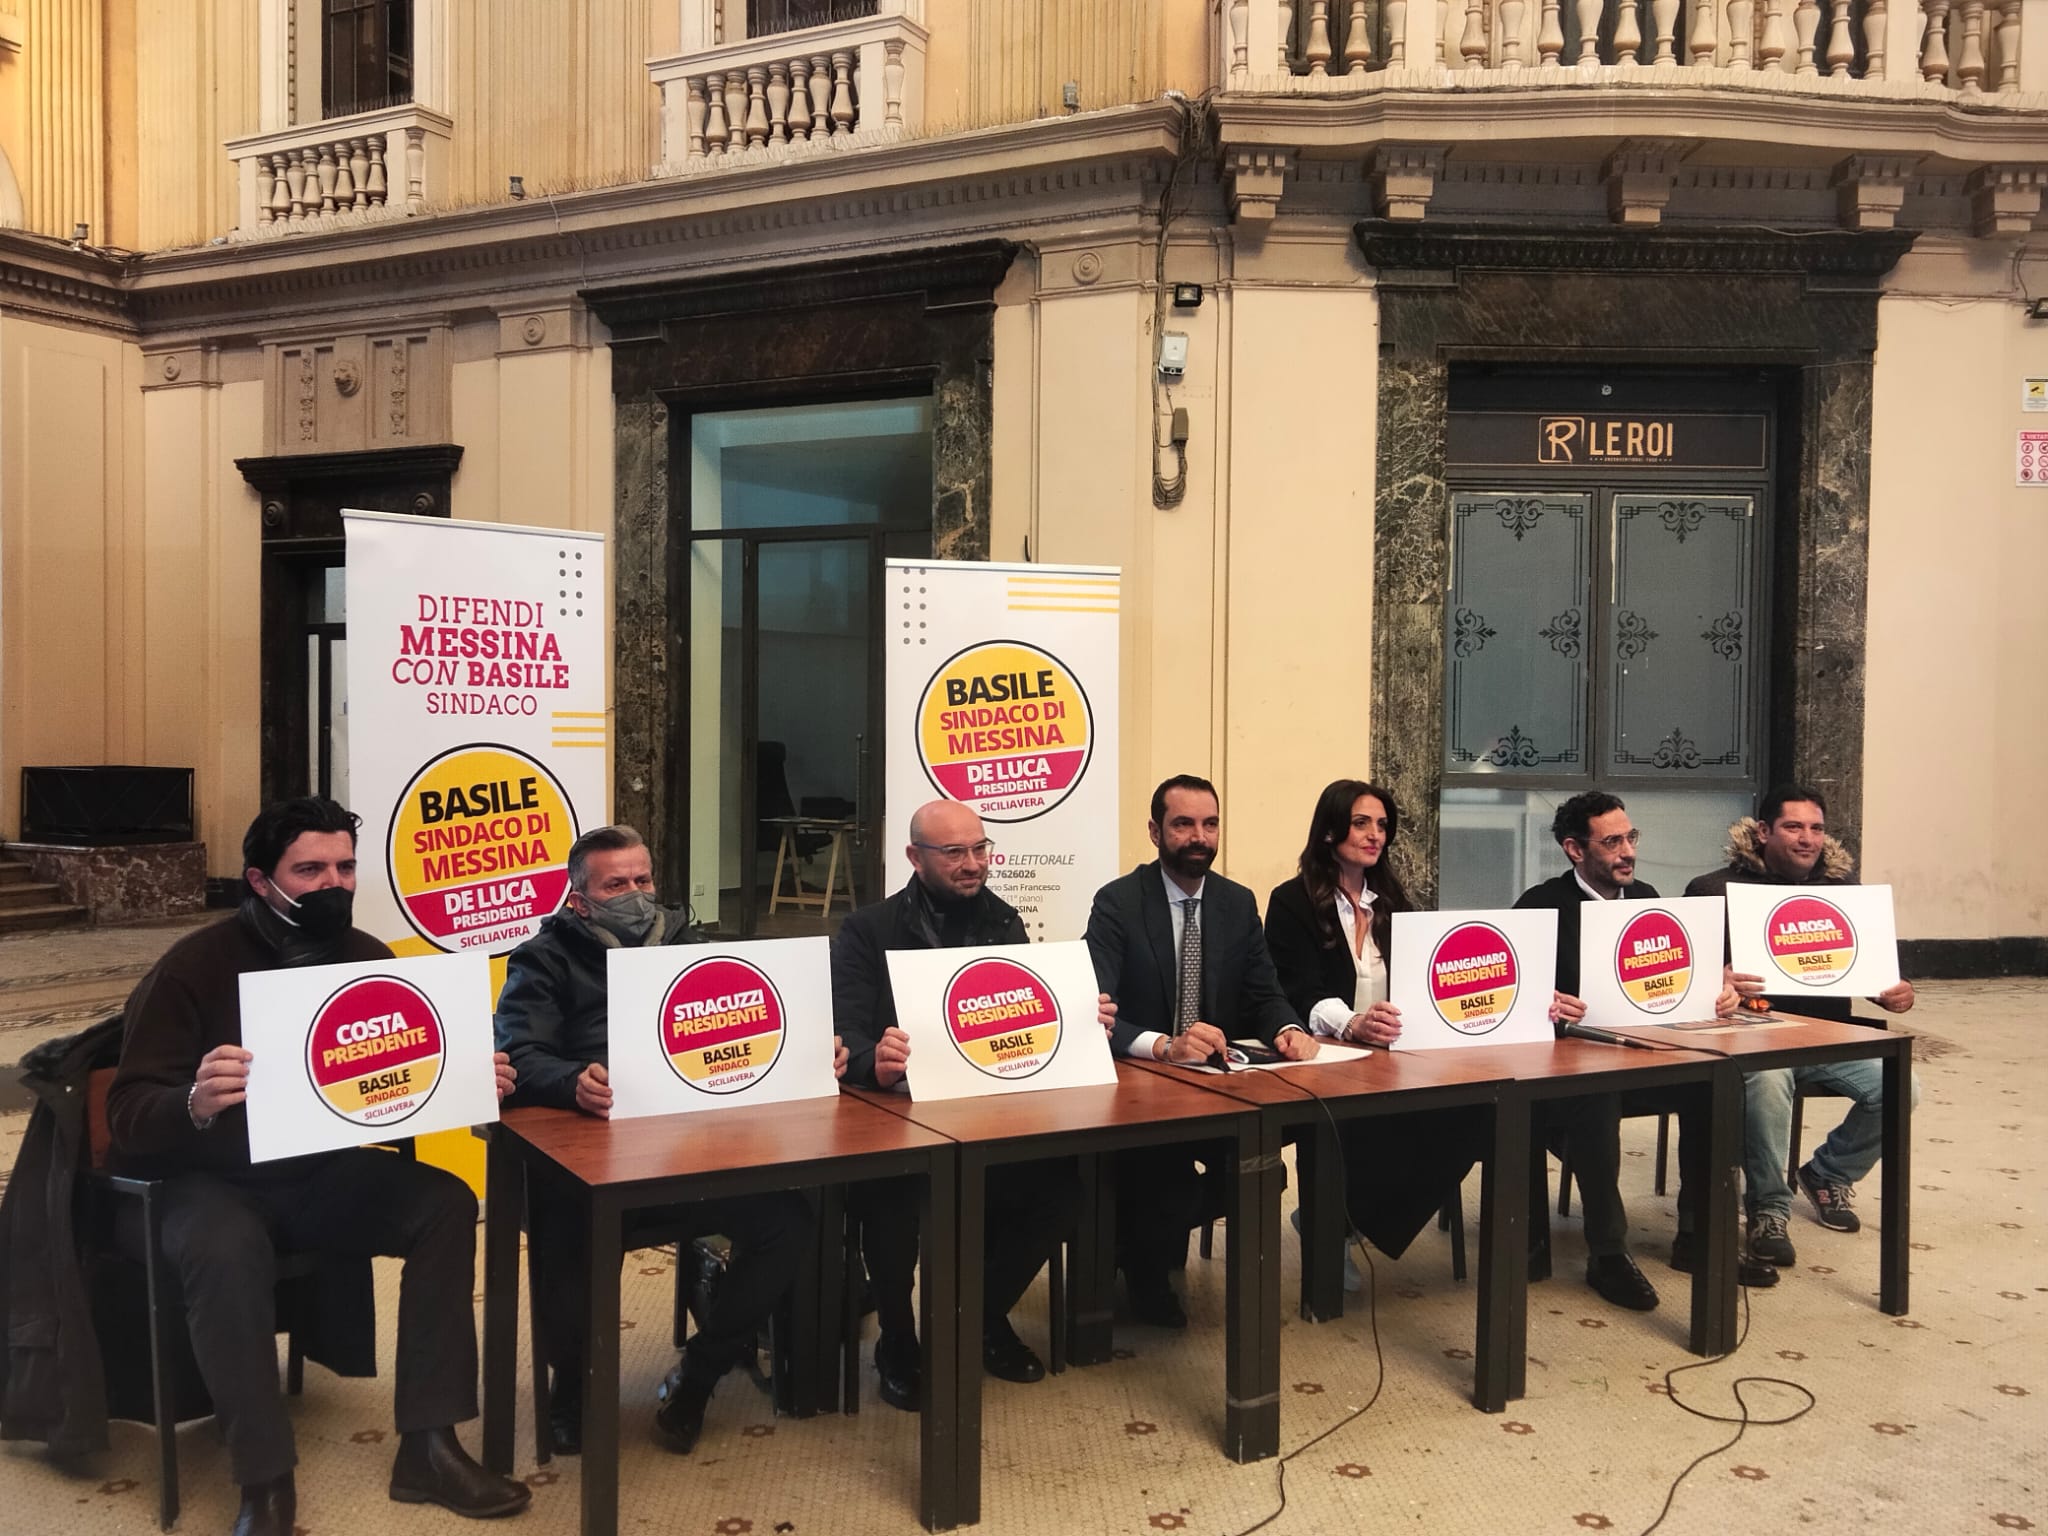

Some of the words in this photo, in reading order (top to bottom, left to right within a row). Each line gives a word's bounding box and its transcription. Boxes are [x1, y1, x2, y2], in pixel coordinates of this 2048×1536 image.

[1589, 422, 1673, 456] LEROI
[418, 594, 544, 628] DIFENDI
[400, 625, 562, 661] MESSINA
[392, 658, 460, 685] CON
[467, 661, 569, 688] BASILE
[946, 670, 1055, 706] BASILE
[427, 692, 537, 715] SINDACO
[940, 703, 1039, 731] SINDACO
[1043, 700, 1065, 721] DI
[948, 724, 1065, 755] MESSINA
[967, 764, 994, 784] DE
[997, 757, 1051, 780] LUCA
[974, 778, 1047, 796] PRESIDENTE
[419, 777, 539, 824] BASILE
[980, 797, 1045, 812] SICILIAVERA
[413, 816, 522, 854] SINDACO
[527, 812, 551, 836] DI
[422, 839, 550, 883] MESSINA
[1008, 854, 1075, 866] ELETTORALE
[444, 890, 474, 915] DE
[478, 879, 537, 909] LUCA
[1003, 883, 1018, 892] San
[1020, 883, 1061, 891] Francesco
[1019, 894, 1044, 904] piano)
[453, 903, 532, 930] PRESIDENTE
[1779, 921, 1798, 935] LA
[1798, 918, 1836, 933] ROSA
[460, 925, 530, 948] SICILIAVERA
[1633, 934, 1671, 956] BALDI
[1774, 929, 1844, 946] PRESIDENTE
[1435, 951, 1507, 975] MANGANARO
[1623, 947, 1684, 970] PRESIDENTE
[1797, 954, 1833, 966] BASILE
[1438, 963, 1508, 988] PRESIDENTE
[1644, 976, 1674, 991] BASILE
[673, 988, 765, 1022] STRACUZZI
[957, 987, 1034, 1012] COGLITORE
[1460, 994, 1495, 1011] BASILE
[672, 1004, 769, 1039] PRESIDENTE
[957, 1000, 1043, 1028] PRESIDENTE
[1463, 1017, 1497, 1030] SICILIAVERA
[1464, 1006, 1494, 1018] SINDACO
[336, 1011, 408, 1046] COSTA
[322, 1026, 428, 1068] PRESIDENTE
[703, 1042, 752, 1065] BASILE
[989, 1032, 1034, 1053] BASILE
[996, 1047, 1034, 1061] SINDACO
[708, 1058, 750, 1074] SINDACO
[997, 1058, 1040, 1074] SICILIAVERA
[358, 1068, 411, 1095] BASILE
[707, 1071, 755, 1088] SICILIAVERA
[365, 1086, 409, 1106] SINDACO
[364, 1100, 415, 1120] SICILIAVERA
